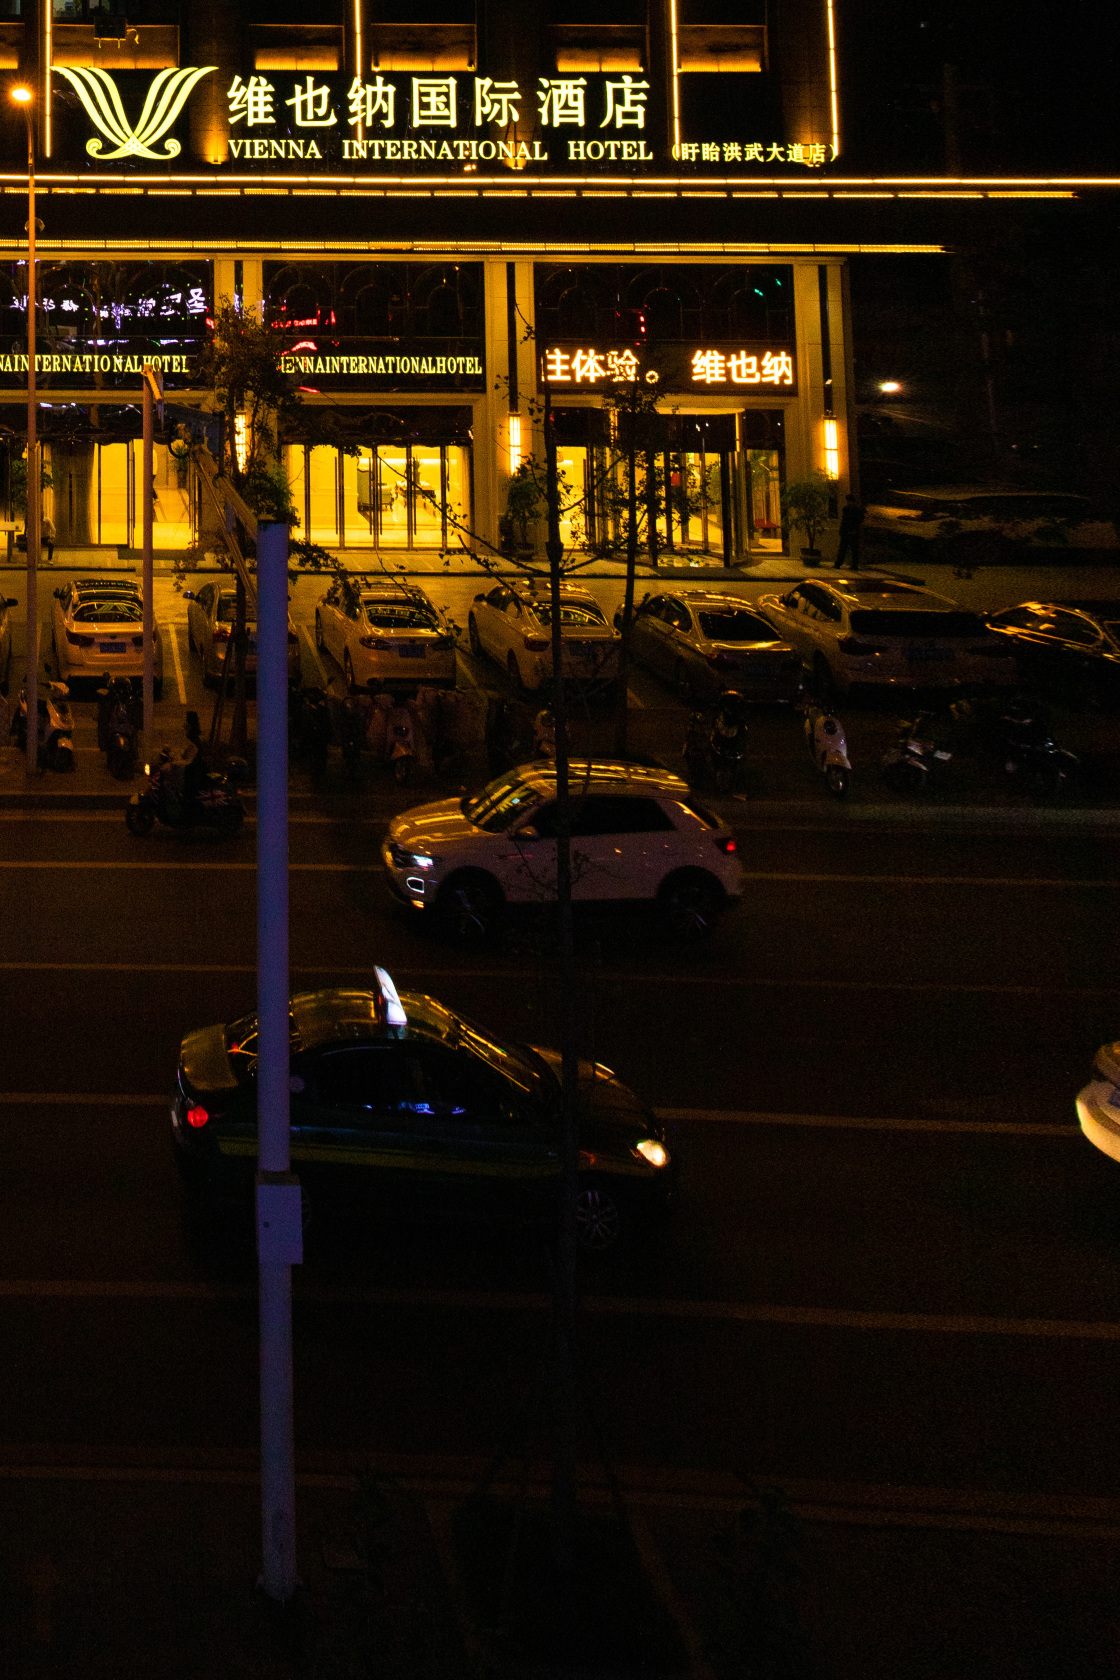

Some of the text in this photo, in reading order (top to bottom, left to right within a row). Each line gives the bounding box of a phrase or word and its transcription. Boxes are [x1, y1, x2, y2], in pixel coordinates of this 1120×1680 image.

[226, 75, 650, 129] 维也纳国际酒店
[228, 139, 653, 160] VIENNA INTERNATIONAL HOTEL
[275, 356, 483, 374] IENNAINTERNATIONALHOTEL
[691, 350, 793, 385] 维也纳
